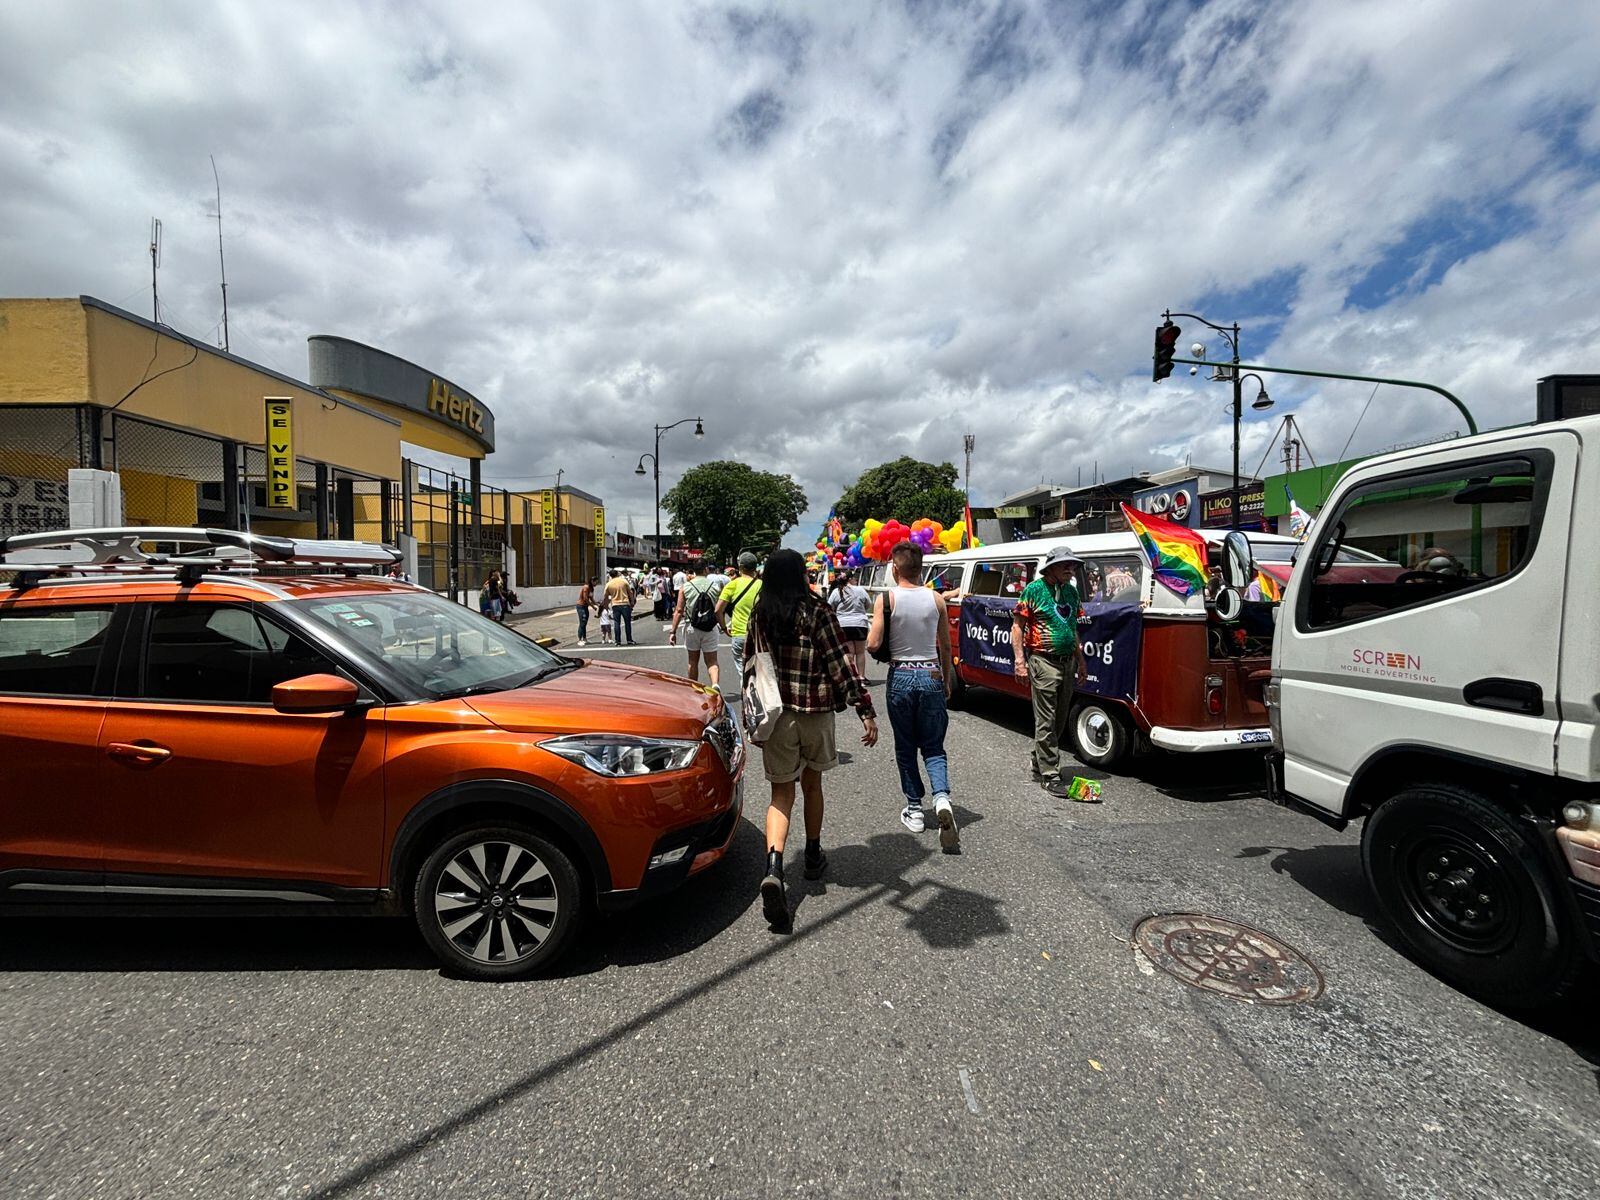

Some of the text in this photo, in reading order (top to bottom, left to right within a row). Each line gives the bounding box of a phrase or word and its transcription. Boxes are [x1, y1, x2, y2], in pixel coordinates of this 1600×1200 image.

[428, 377, 484, 434] Hertz
[271, 405, 289, 505] SE VENDE
[1208, 492, 1265, 510] LIKO PRESS
[965, 623, 1115, 665] Vote fro org
[1340, 664, 1437, 683] MOBILE ADVERTISING
